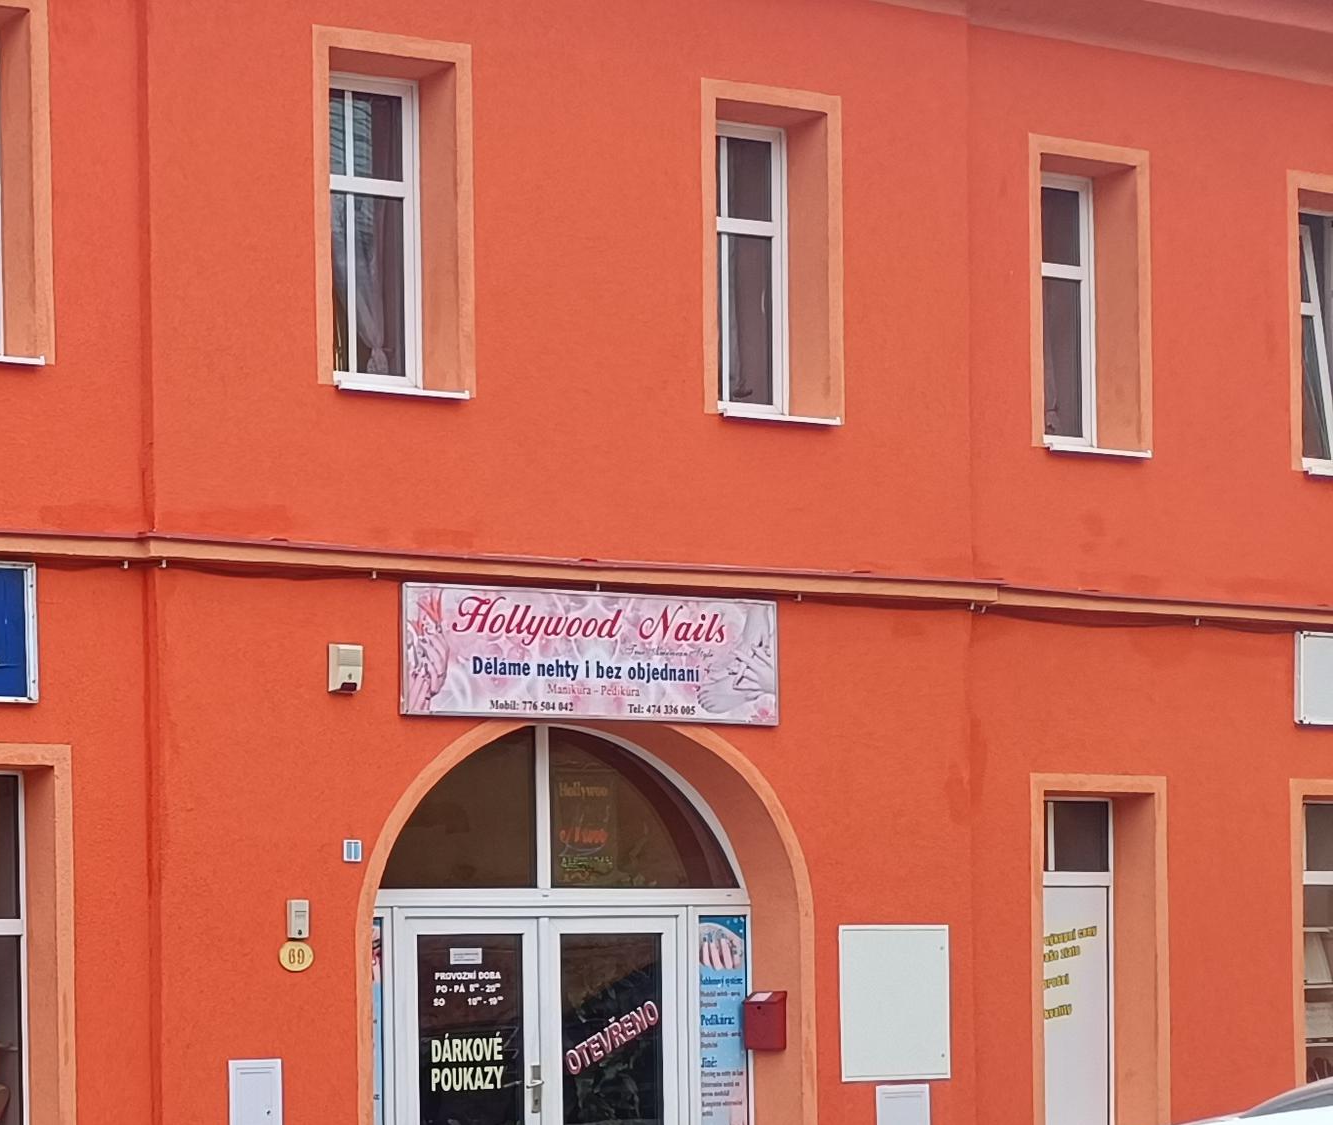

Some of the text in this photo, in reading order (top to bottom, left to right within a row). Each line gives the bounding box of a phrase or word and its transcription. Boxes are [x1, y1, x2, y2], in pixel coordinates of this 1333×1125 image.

[451, 596, 726, 646] Hollywood Nails
[472, 655, 531, 677] Děláme
[537, 658, 580, 681] nehty
[585, 660, 591, 679] i
[596, 660, 622, 680] bez
[489, 699, 574, 712] Mobil: 776 504 042
[628, 703, 644, 714] Tel:
[646, 704, 661, 715] 474
[434, 970, 501, 981] PROVOZNÍ DOBA
[435, 984, 448, 993] PO
[454, 983, 466, 993] PÁ
[431, 1031, 503, 1063] DÁRKOVÉ
[565, 1000, 659, 1075] OTEVŘENO
[431, 1065, 504, 1092] POUKAZY
